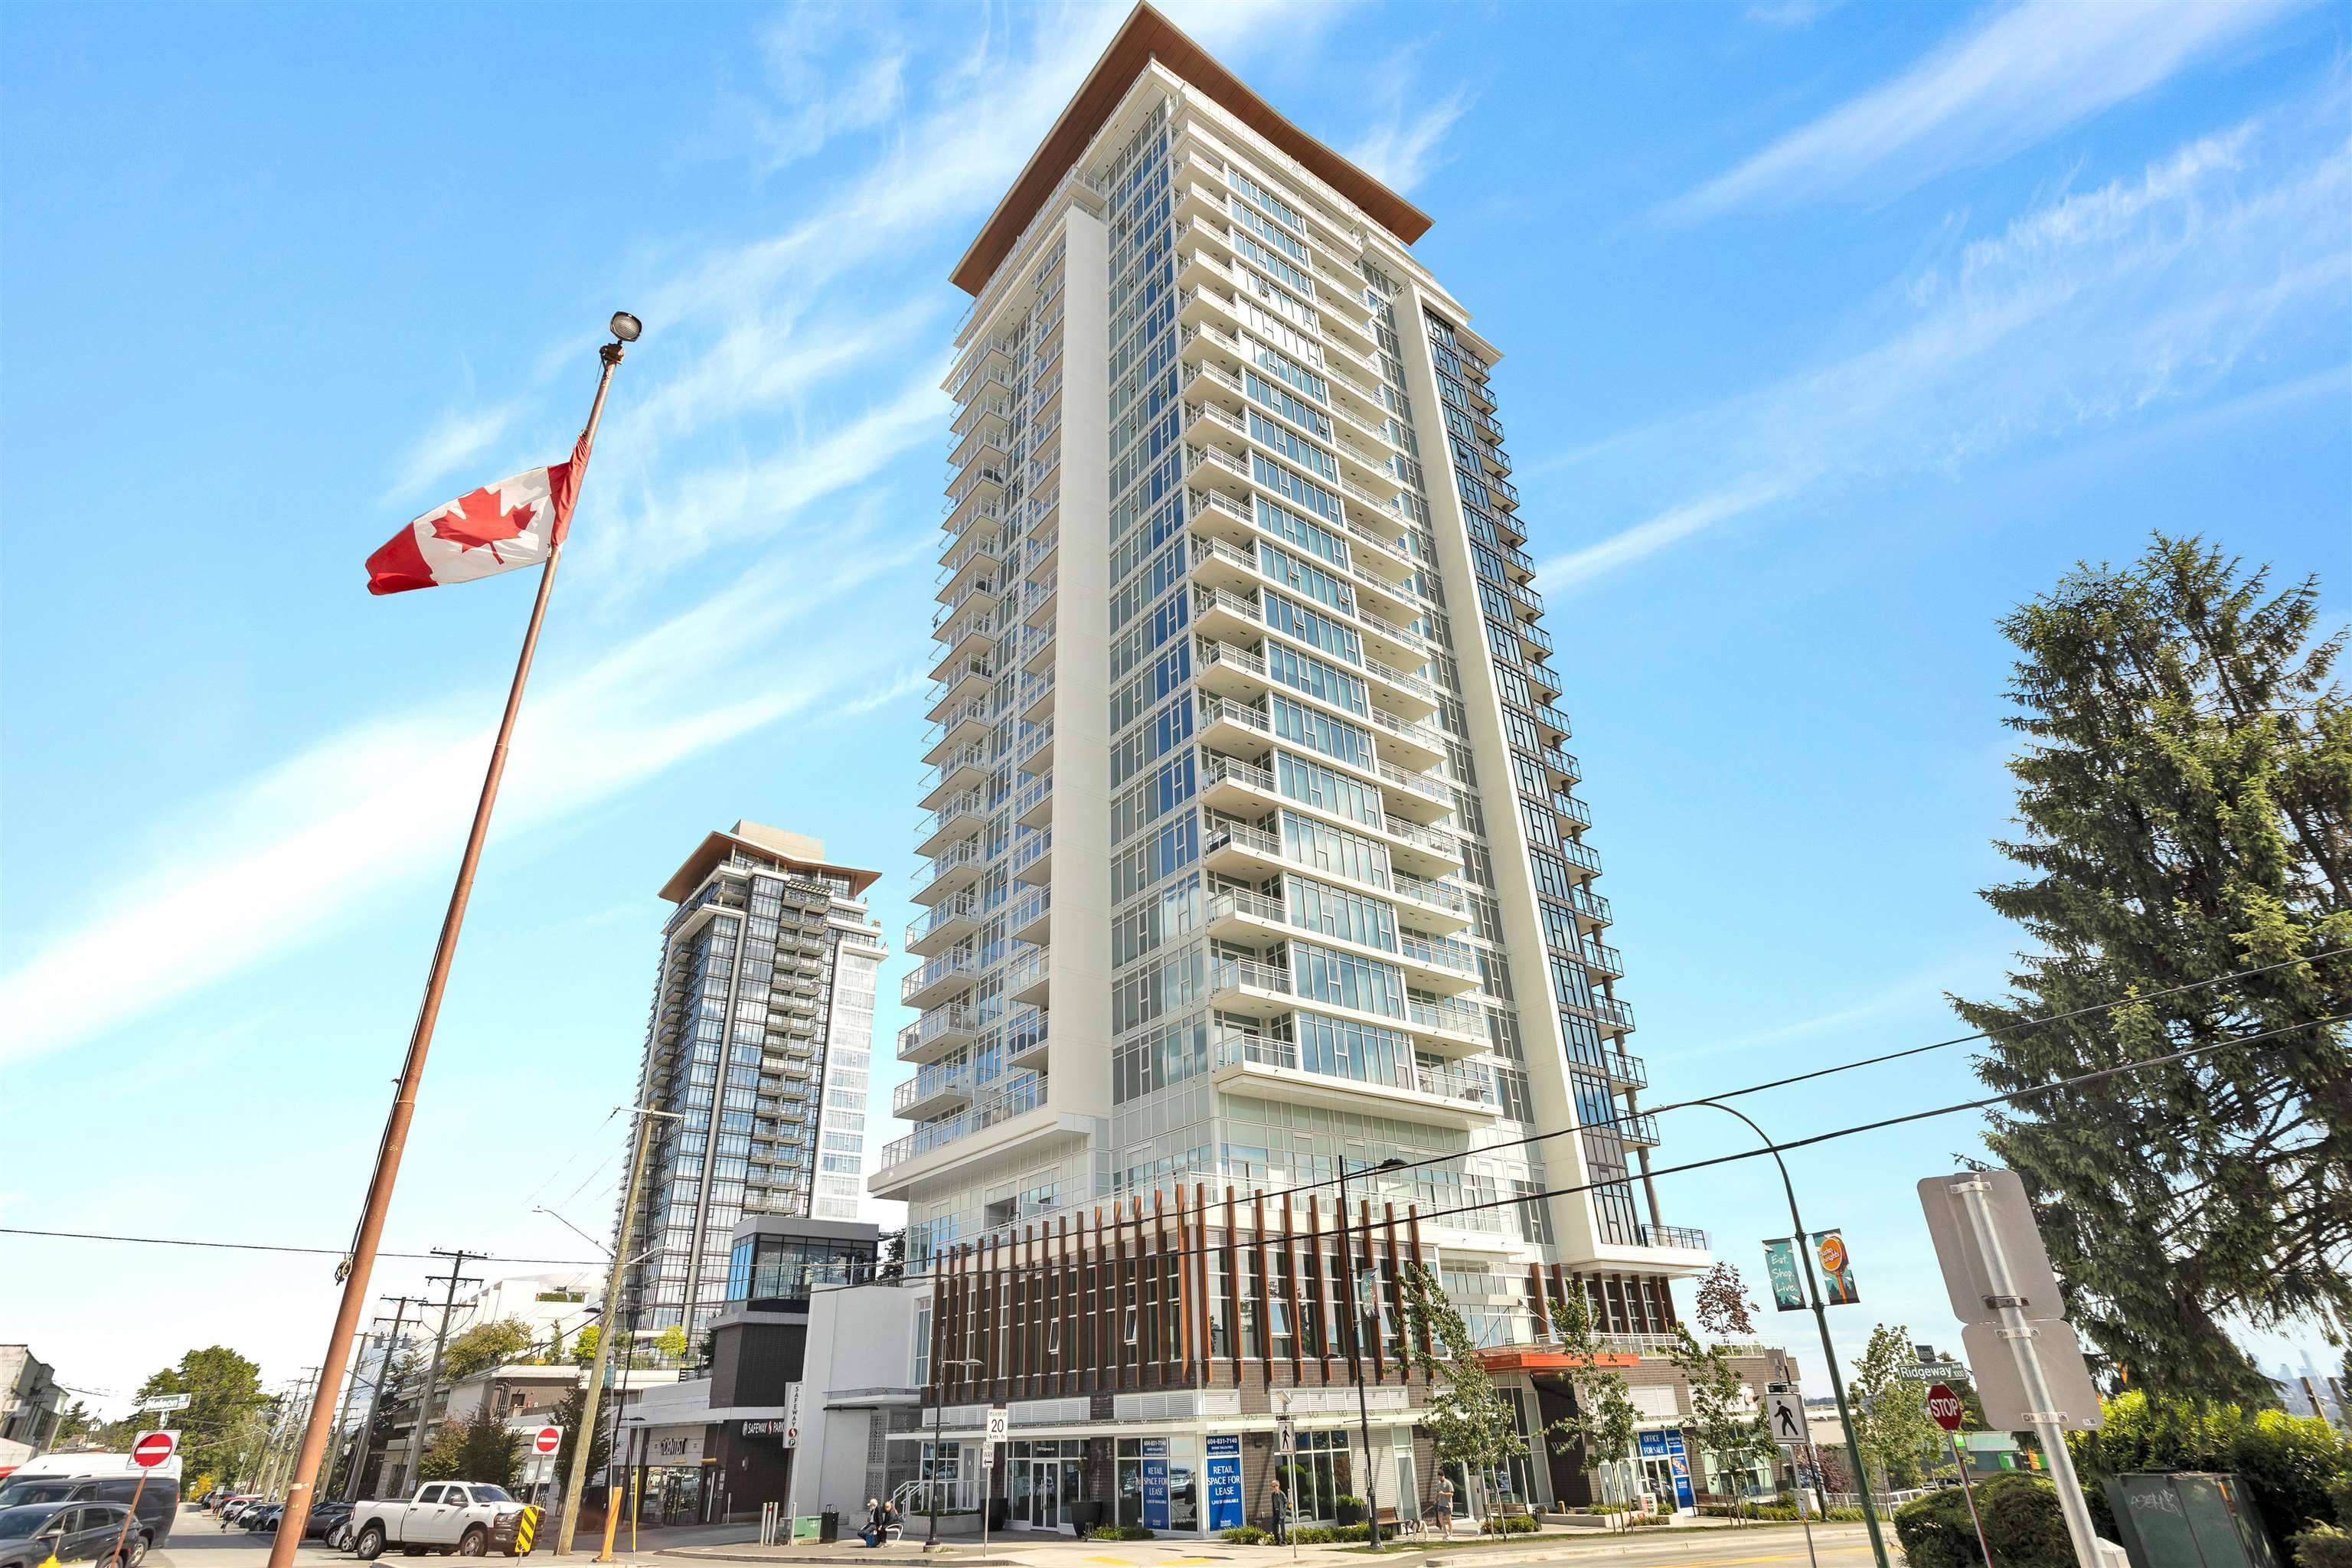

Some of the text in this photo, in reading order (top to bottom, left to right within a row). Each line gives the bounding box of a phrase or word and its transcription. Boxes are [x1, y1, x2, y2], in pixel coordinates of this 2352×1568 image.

[1771, 1255, 1789, 1265] Eat.
[1772, 1268, 1795, 1282] Shop.
[1775, 1282, 1798, 1292] Live.
[1900, 1367, 1952, 1380] Ridgeway
[1929, 1398, 1958, 1417] STOP
[748, 1423, 767, 1434] SAFEWAY
[991, 1419, 1004, 1432] 20
[1213, 1466, 1234, 1475] RETAIL
[1207, 1475, 1240, 1485] SPACE FOR
[1215, 1487, 1234, 1495] LEASE
